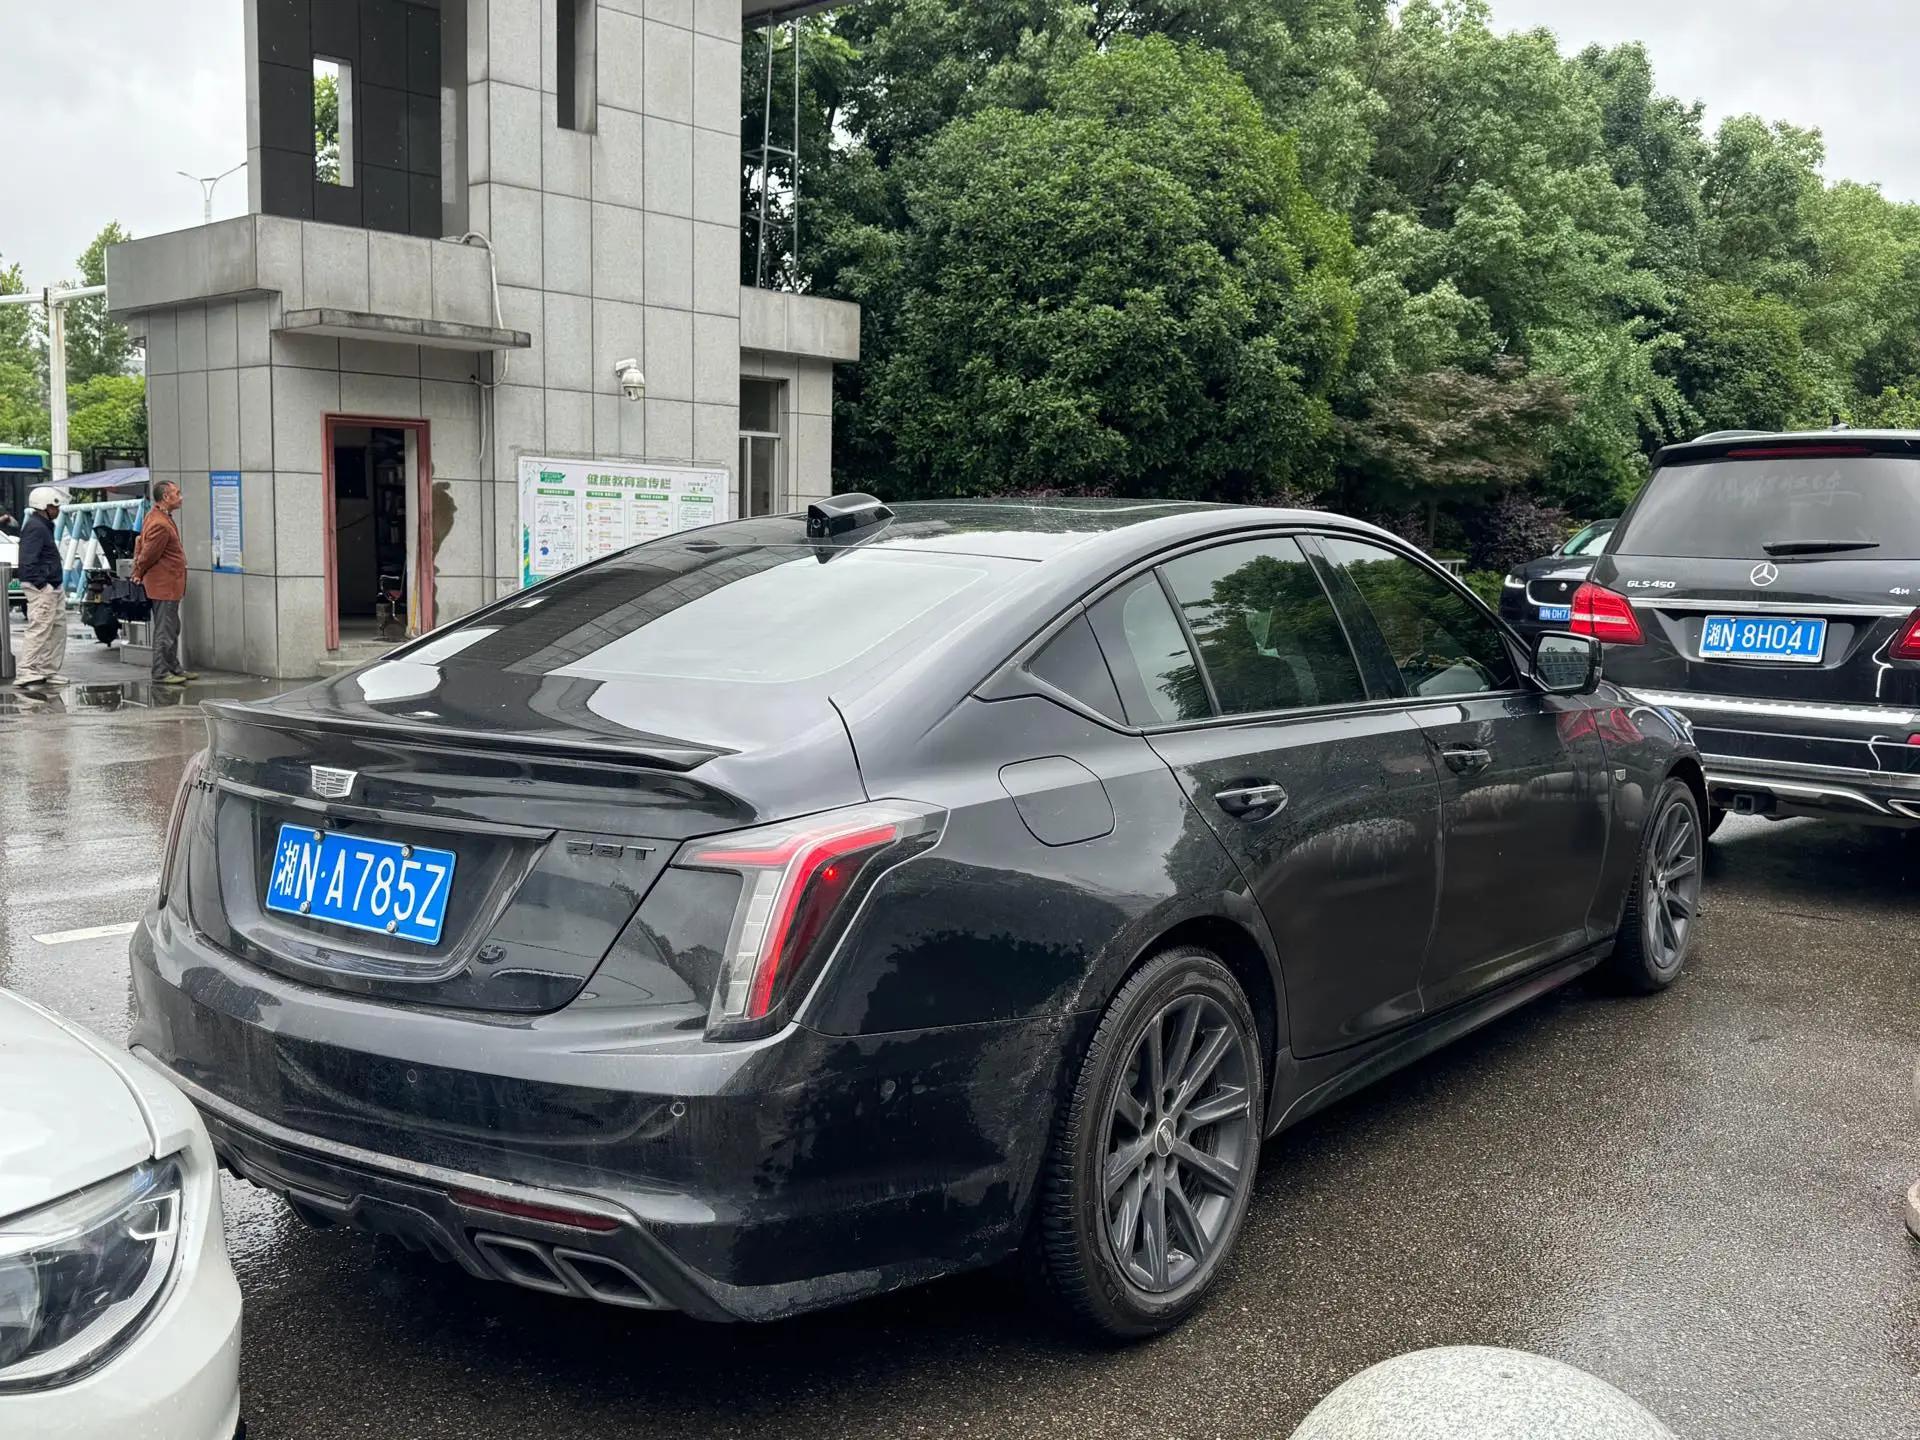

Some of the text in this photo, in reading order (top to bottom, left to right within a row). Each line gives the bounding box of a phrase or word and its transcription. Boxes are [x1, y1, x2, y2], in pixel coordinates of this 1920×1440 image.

[587, 473, 672, 490] 健康教育宣传栏
[1706, 623, 1816, 651] 湘N·8H041
[274, 840, 447, 928] 湘N·A785Z
